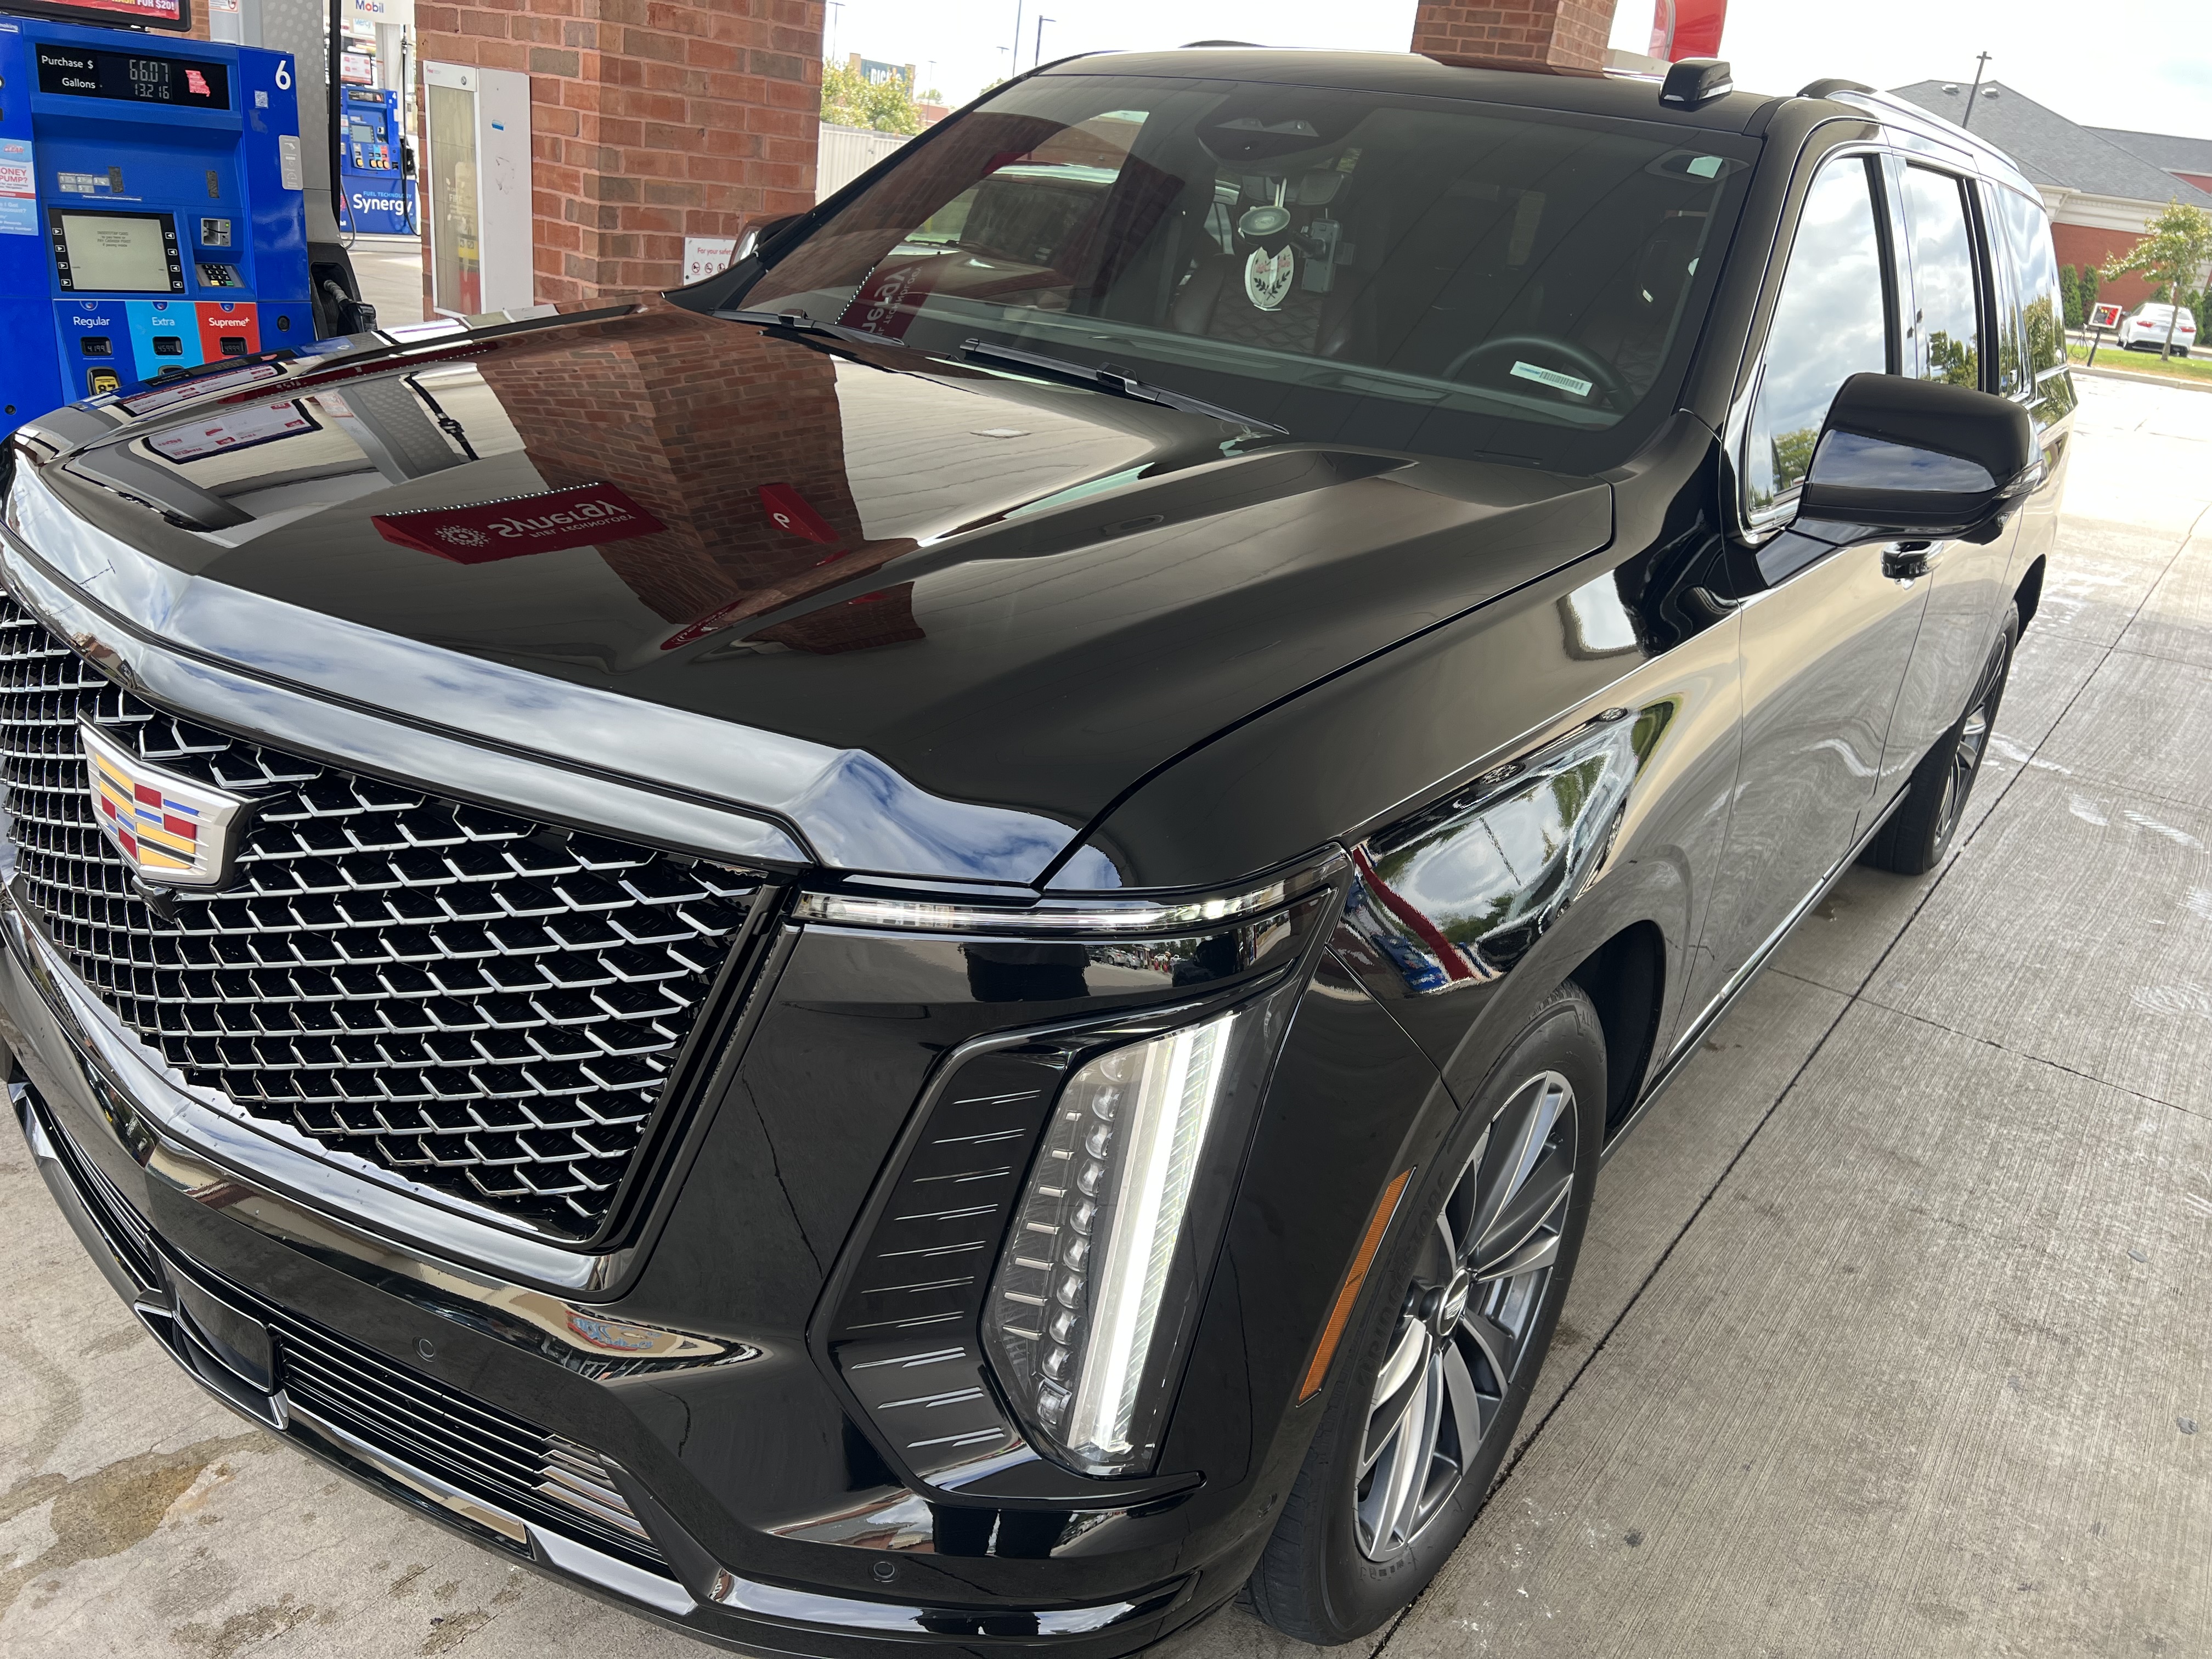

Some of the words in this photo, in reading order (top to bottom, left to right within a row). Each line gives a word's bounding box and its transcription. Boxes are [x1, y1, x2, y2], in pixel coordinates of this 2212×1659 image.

[156, 0, 174, 10] $20!
[356, 0, 384, 13] Mobil
[41, 55, 83, 68] Purchase
[87, 60, 94, 70] $
[275, 60, 291, 90] 6
[62, 77, 96, 89] Gallons
[353, 194, 413, 216] Synergy
[73, 316, 110, 328] Regular
[151, 317, 176, 326] Extra
